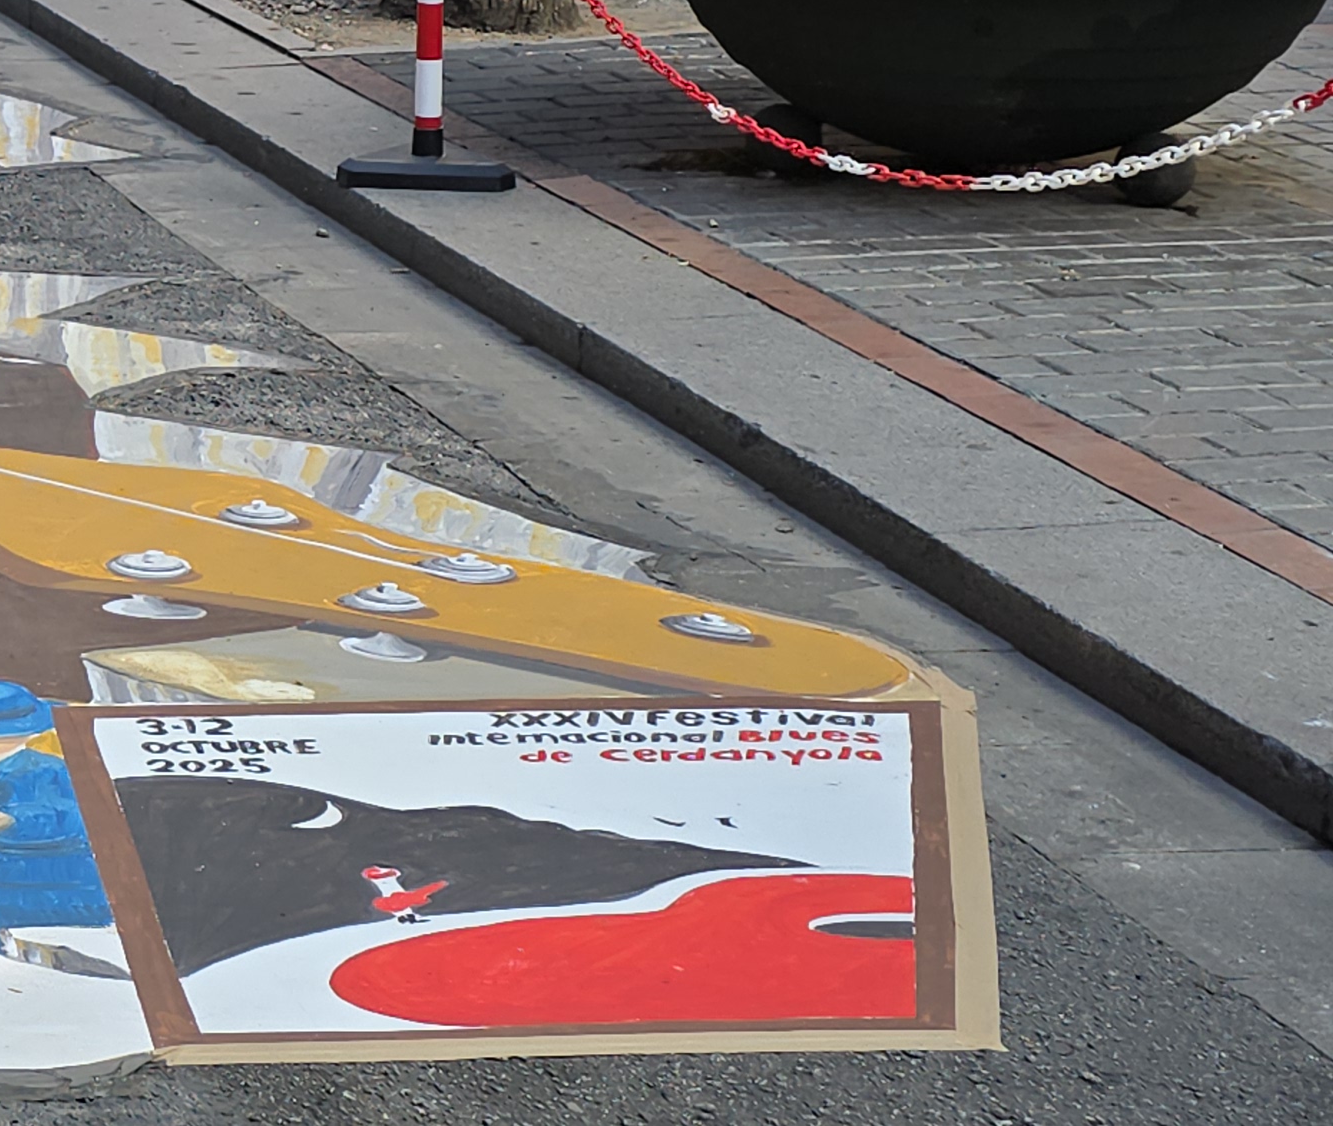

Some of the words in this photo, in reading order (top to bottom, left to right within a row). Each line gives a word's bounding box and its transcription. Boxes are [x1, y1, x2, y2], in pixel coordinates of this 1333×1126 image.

[489, 710, 634, 728] XXXIV
[646, 708, 877, 728] Festival
[136, 718, 234, 735] 3-12
[427, 730, 725, 746] Internacional
[141, 739, 321, 755] OCTUBRE
[519, 747, 574, 763] de
[146, 757, 272, 774] 2025
